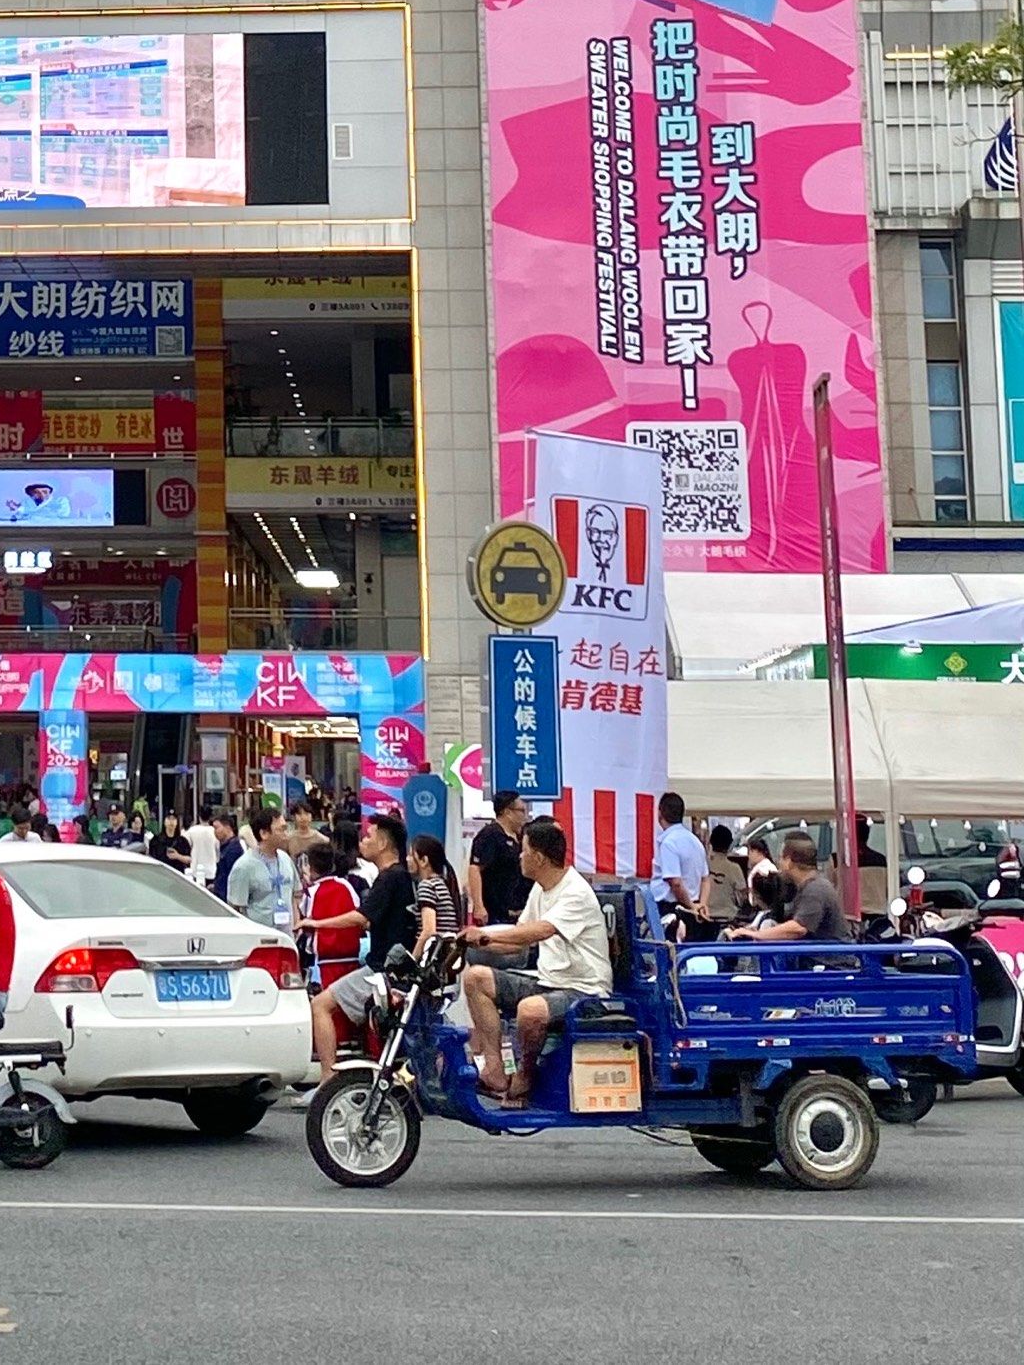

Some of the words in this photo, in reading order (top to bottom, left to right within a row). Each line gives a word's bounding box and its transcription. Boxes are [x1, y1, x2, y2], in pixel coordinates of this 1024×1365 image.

[589, 41, 609, 138] SWEATER
[612, 39, 633, 143] WELCOME
[616, 147, 634, 176] TO
[593, 142, 613, 247] SHOPPING
[617, 179, 637, 264] DALANG
[597, 251, 618, 355] FESTIVAL!
[621, 269, 641, 362] WOOLEN
[572, 583, 632, 613] KFC
[256, 662, 307, 683] CIW
[558, 638, 665, 677] 起自在
[256, 686, 298, 707] KF
[561, 678, 644, 716] 肯德基
[46, 724, 80, 739] CIW
[375, 726, 409, 741] CIW
[513, 648, 538, 788] 公的候车点
[376, 743, 403, 756] KF
